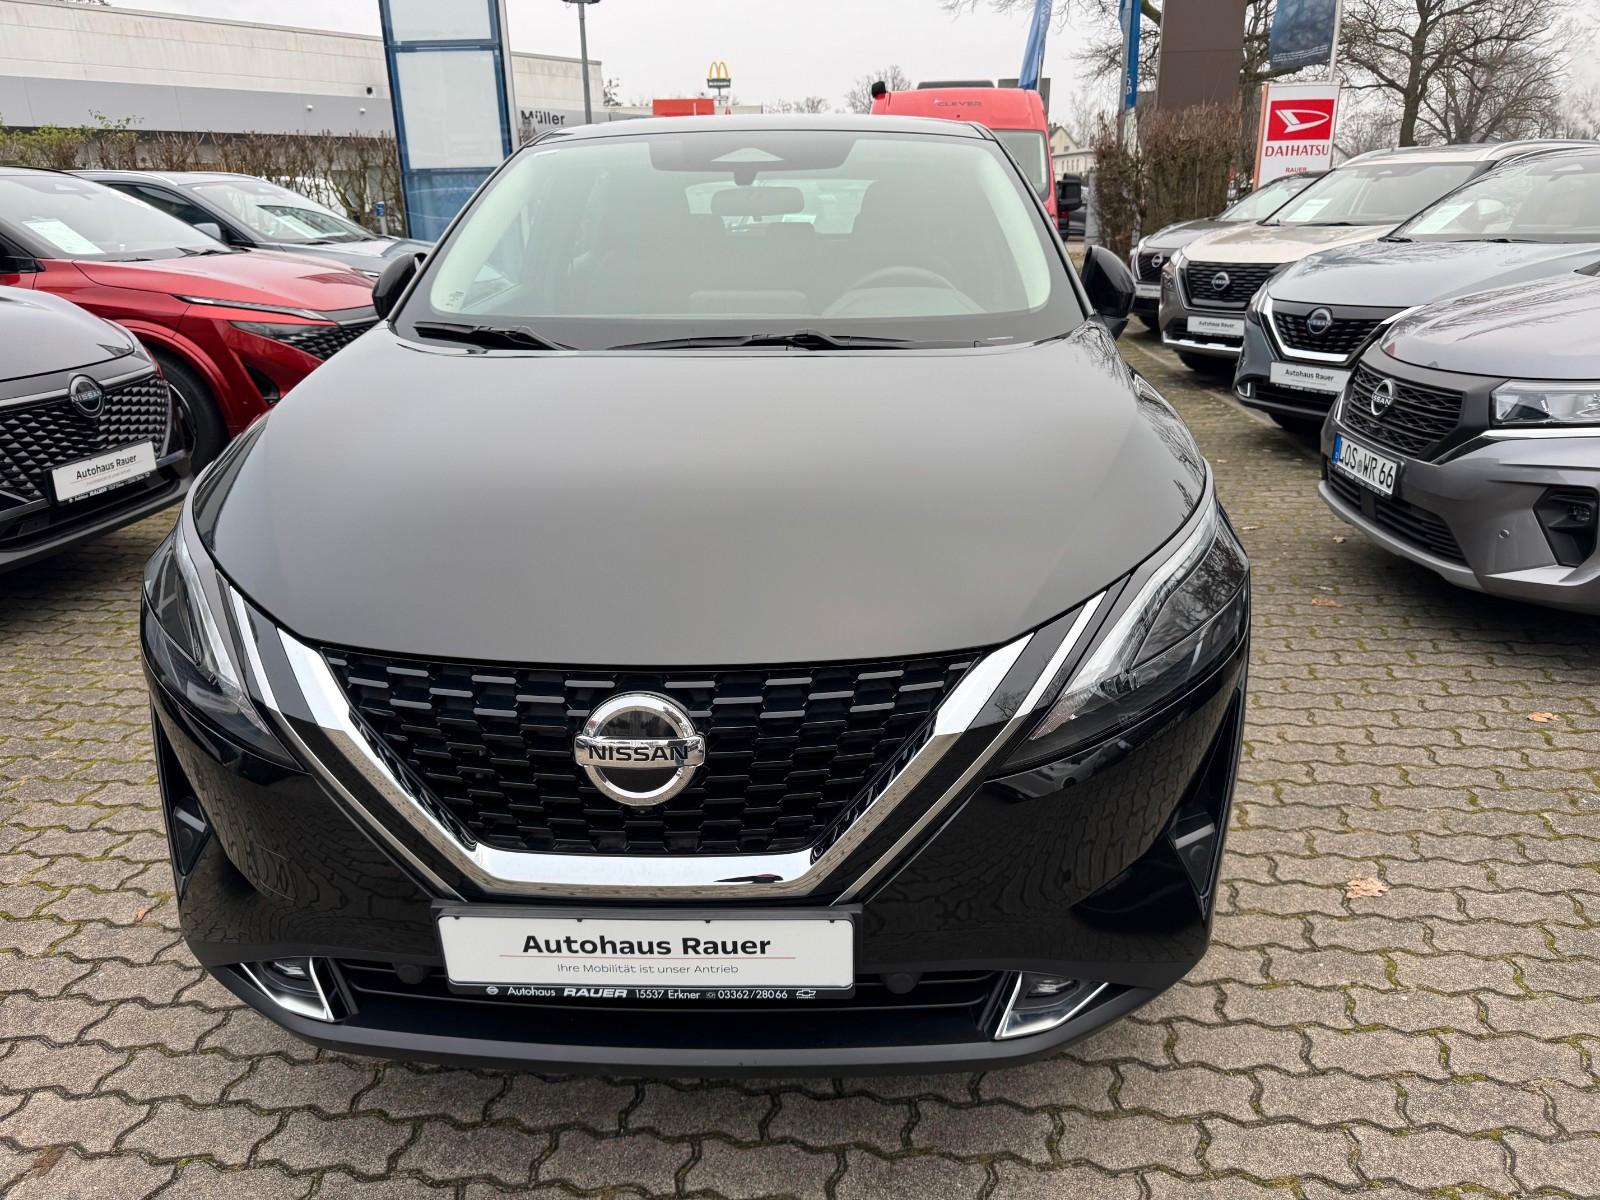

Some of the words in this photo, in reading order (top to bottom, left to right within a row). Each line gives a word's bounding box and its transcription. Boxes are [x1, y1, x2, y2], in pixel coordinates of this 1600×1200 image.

[520, 110, 565, 125] Müller
[1265, 145, 1329, 157] DAIHATSU
[1284, 369, 1314, 379] Autohaus
[1315, 373, 1335, 382] Rauer
[76, 461, 115, 480] Autohaus
[116, 454, 137, 467] Rauer
[1363, 453, 1377, 481] WR
[1379, 463, 1393, 488] 66
[589, 745, 689, 761] NISSAN
[522, 935, 672, 955] Autohaus
[681, 937, 771, 955] Rauer
[557, 963, 580, 973] Ihre
[583, 963, 634, 974] Mobilität
[639, 964, 655, 974] ist
[657, 965, 690, 974] unser
[694, 964, 739, 974] Antrieb
[507, 986, 556, 997] Autohaus
[563, 987, 628, 998] RAUER
[635, 988, 664, 999] 15537
[668, 989, 700, 999] Erkner
[717, 988, 788, 1000] 03362/28066
